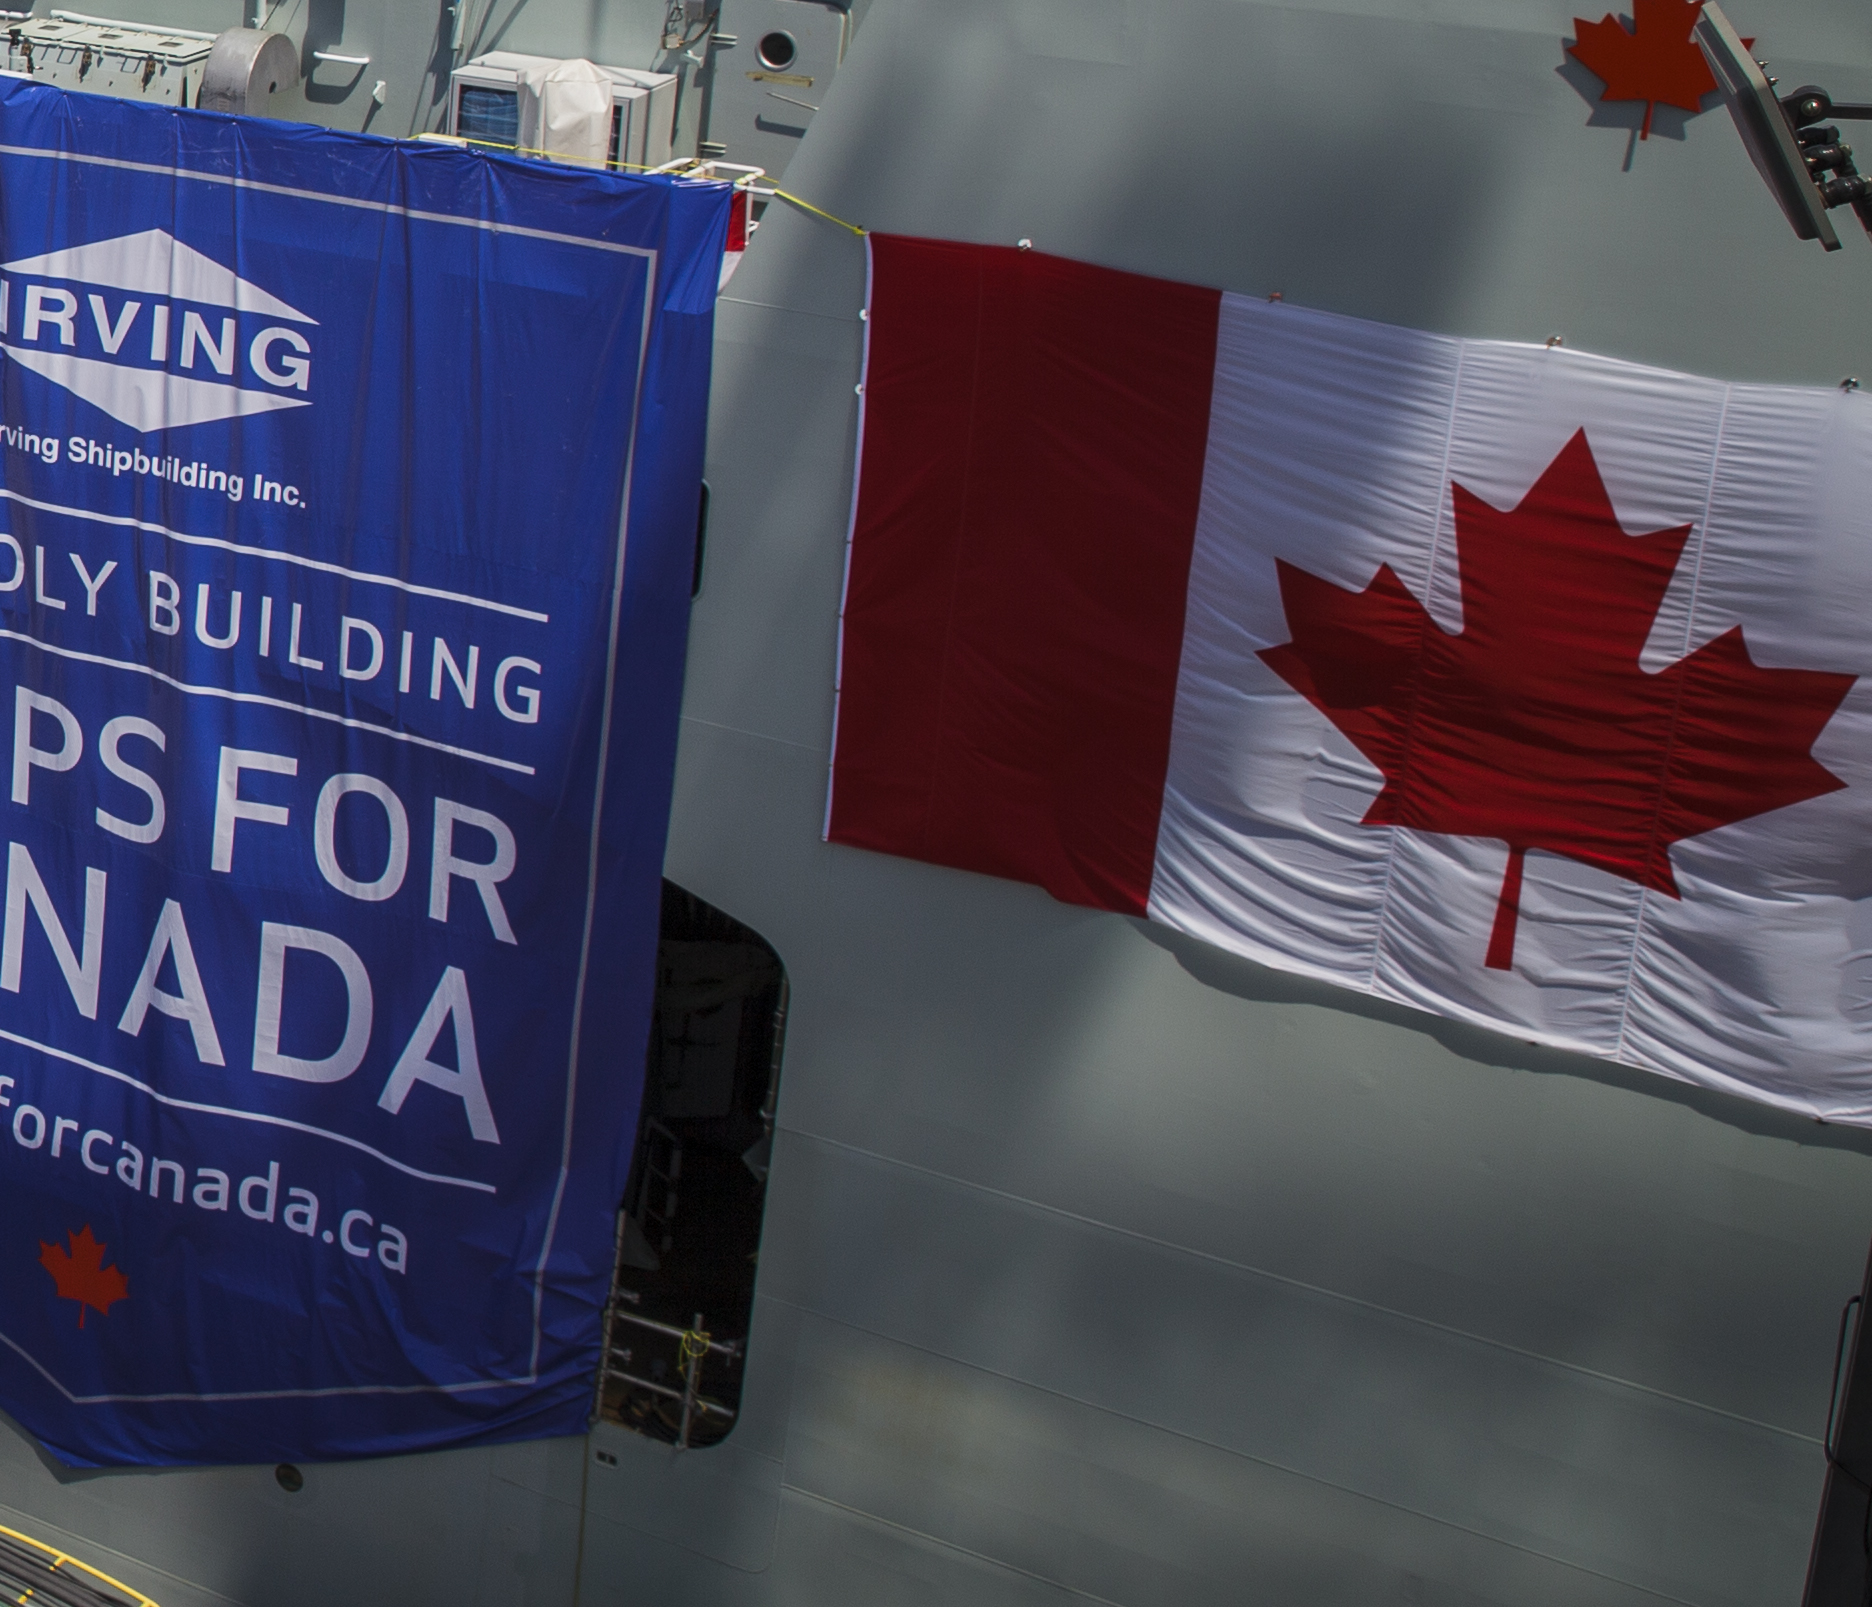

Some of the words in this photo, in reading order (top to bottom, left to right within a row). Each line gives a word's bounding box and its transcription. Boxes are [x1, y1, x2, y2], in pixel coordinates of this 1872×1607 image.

[66, 433, 245, 502] Shipbuilding
[253, 473, 306, 509] Inc.
[149, 569, 542, 724] BUILDING
[210, 745, 518, 945] FOR
